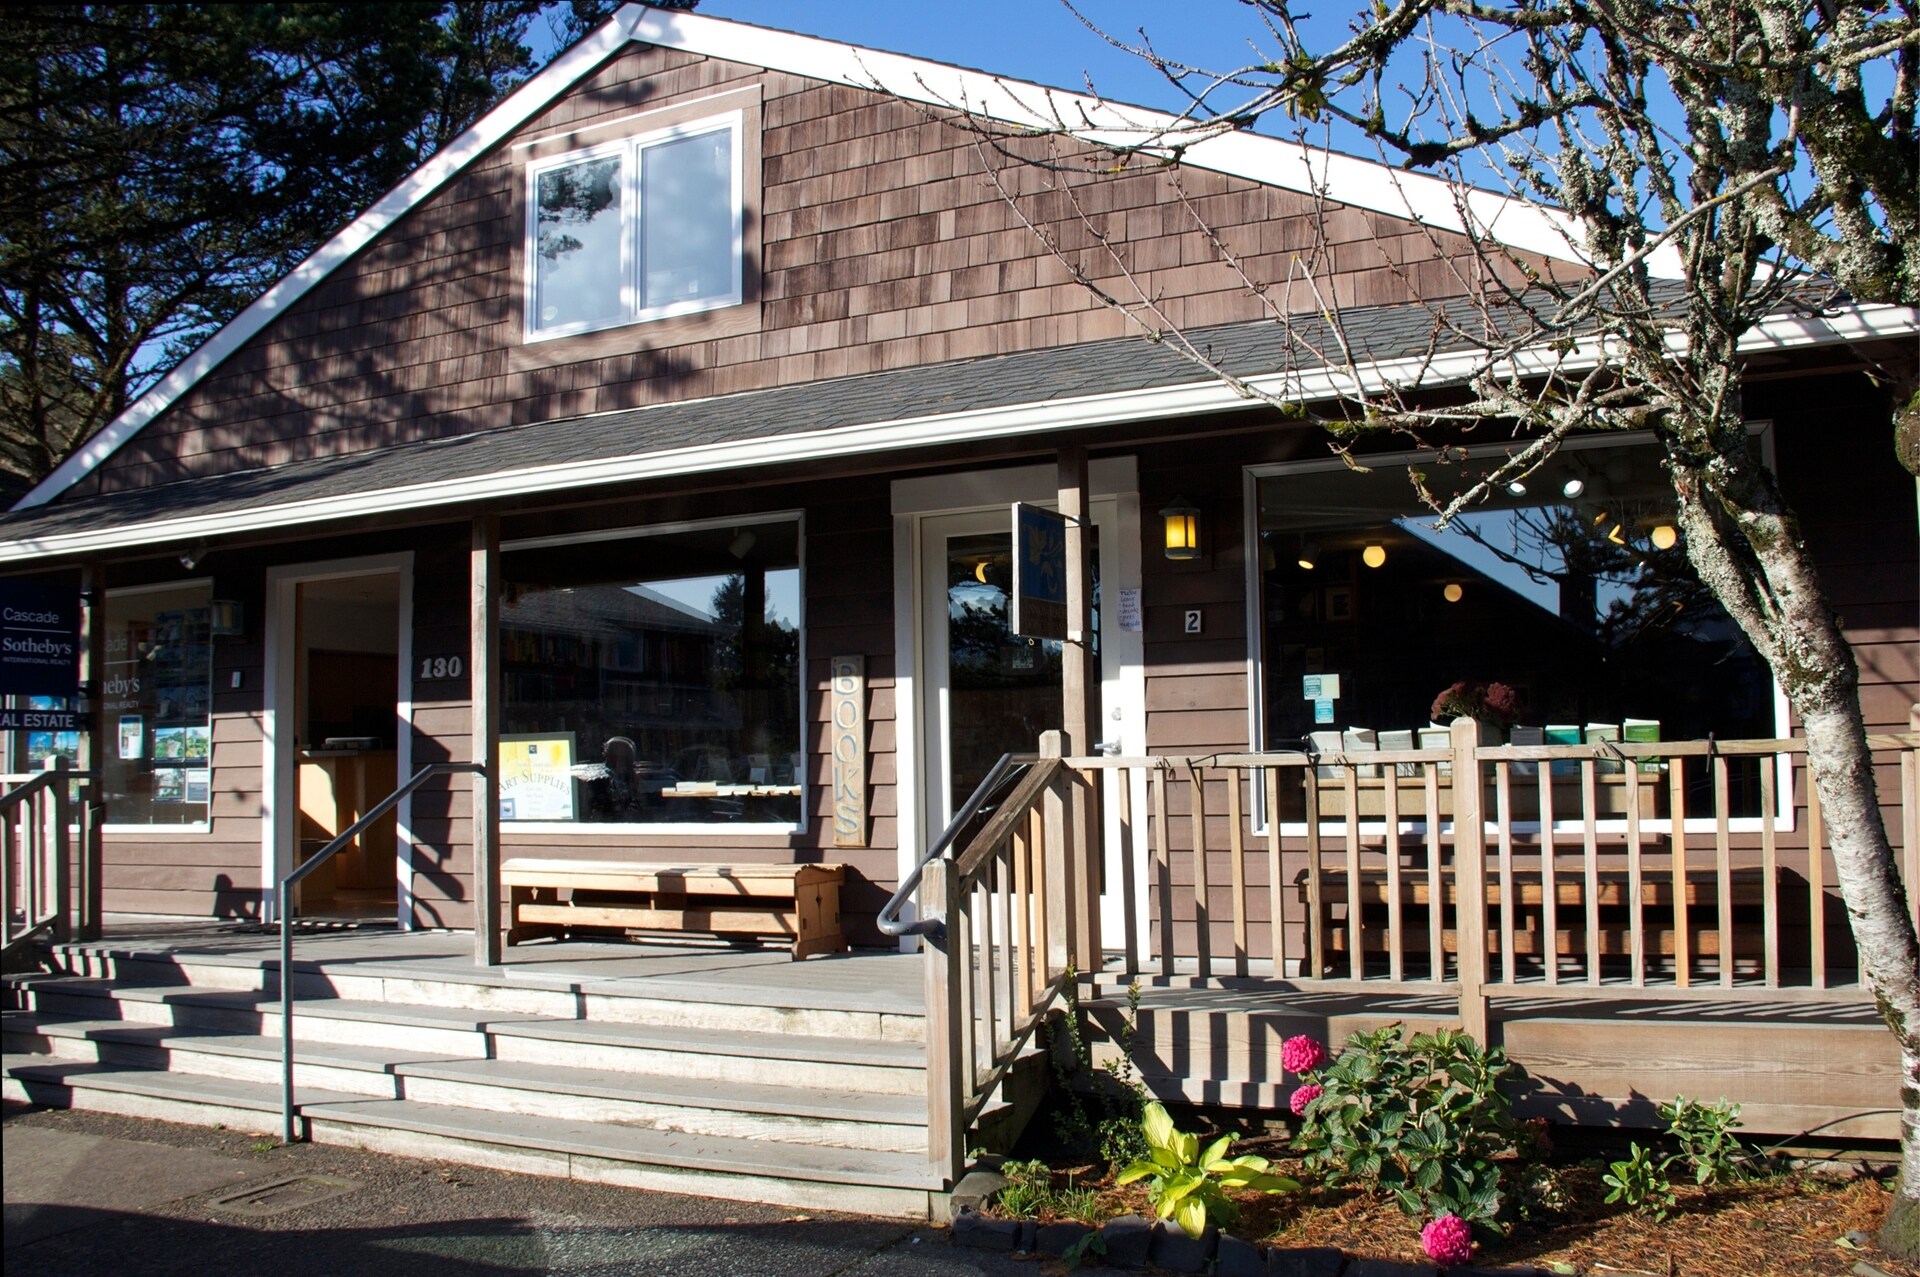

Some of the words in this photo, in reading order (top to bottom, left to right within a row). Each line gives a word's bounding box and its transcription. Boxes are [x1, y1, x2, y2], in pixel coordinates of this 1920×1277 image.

[3, 607, 60, 624] Cascade
[1188, 612, 1199, 631] 2
[2, 637, 72, 657] Sotheby's
[421, 656, 463, 679] 130
[24, 713, 75, 728] ESTATE
[832, 662, 862, 837] BOOKS
